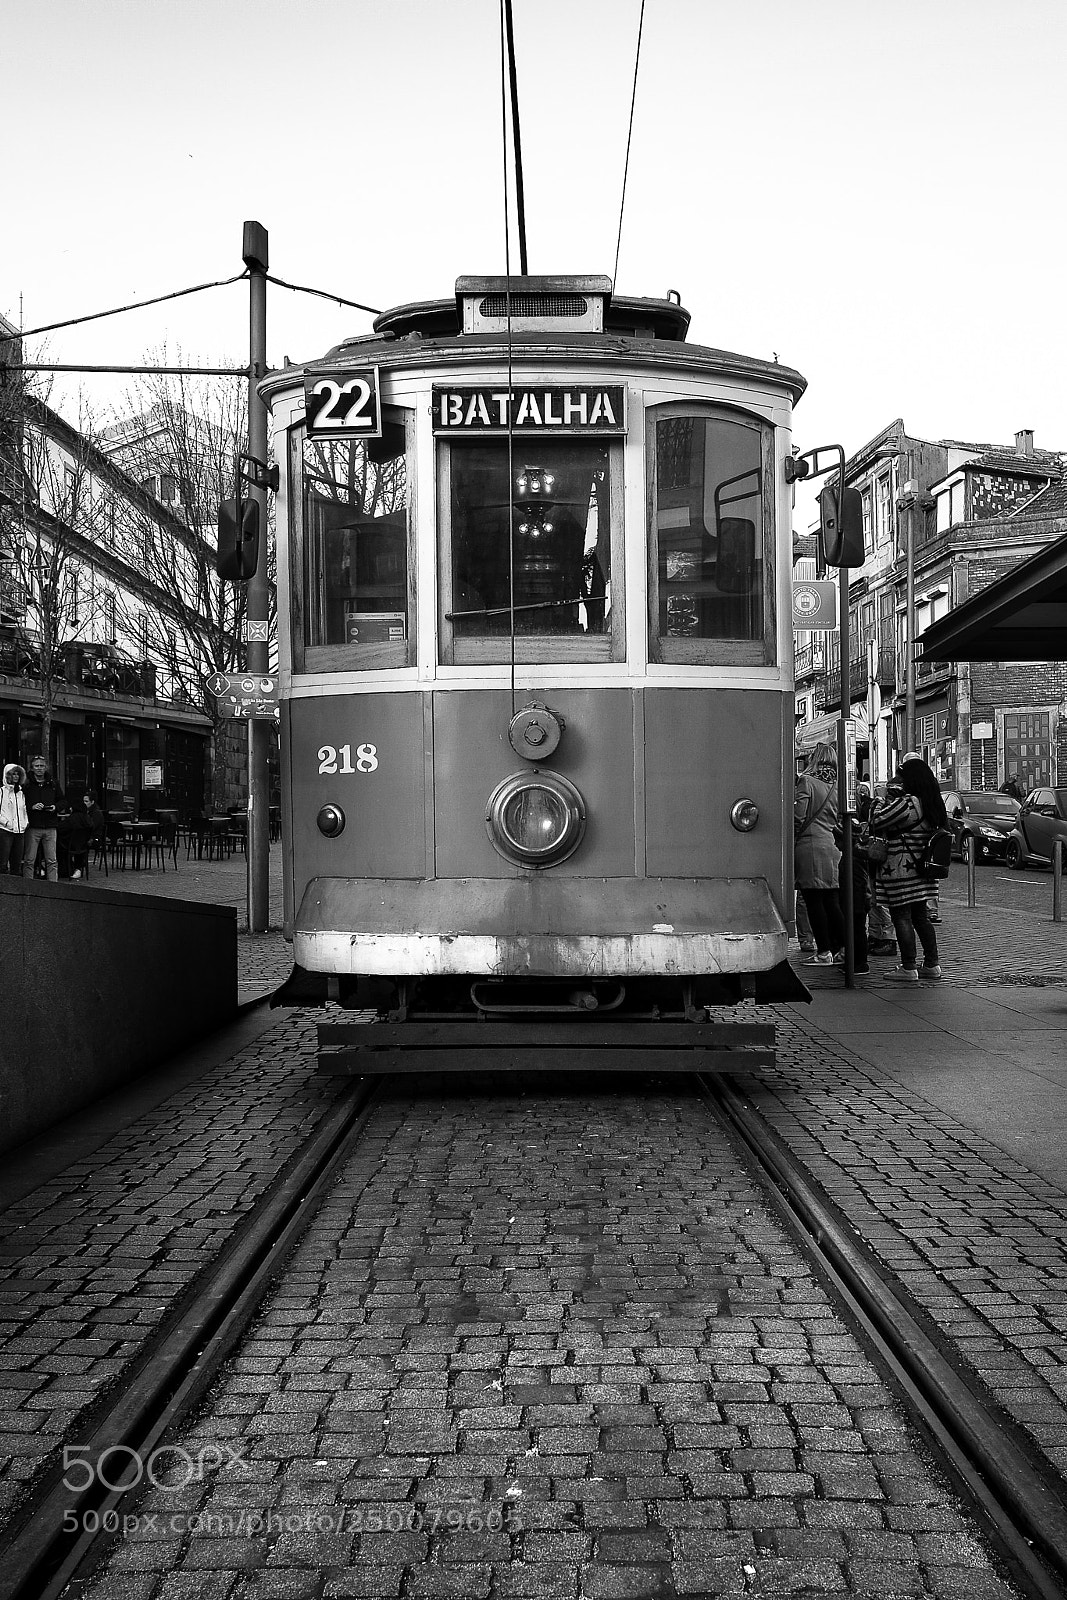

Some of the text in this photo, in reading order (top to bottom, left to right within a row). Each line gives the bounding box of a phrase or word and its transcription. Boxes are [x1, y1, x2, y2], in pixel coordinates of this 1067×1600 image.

[312, 379, 373, 428] 22
[440, 391, 617, 426] BATALHA
[317, 743, 379, 774] 218
